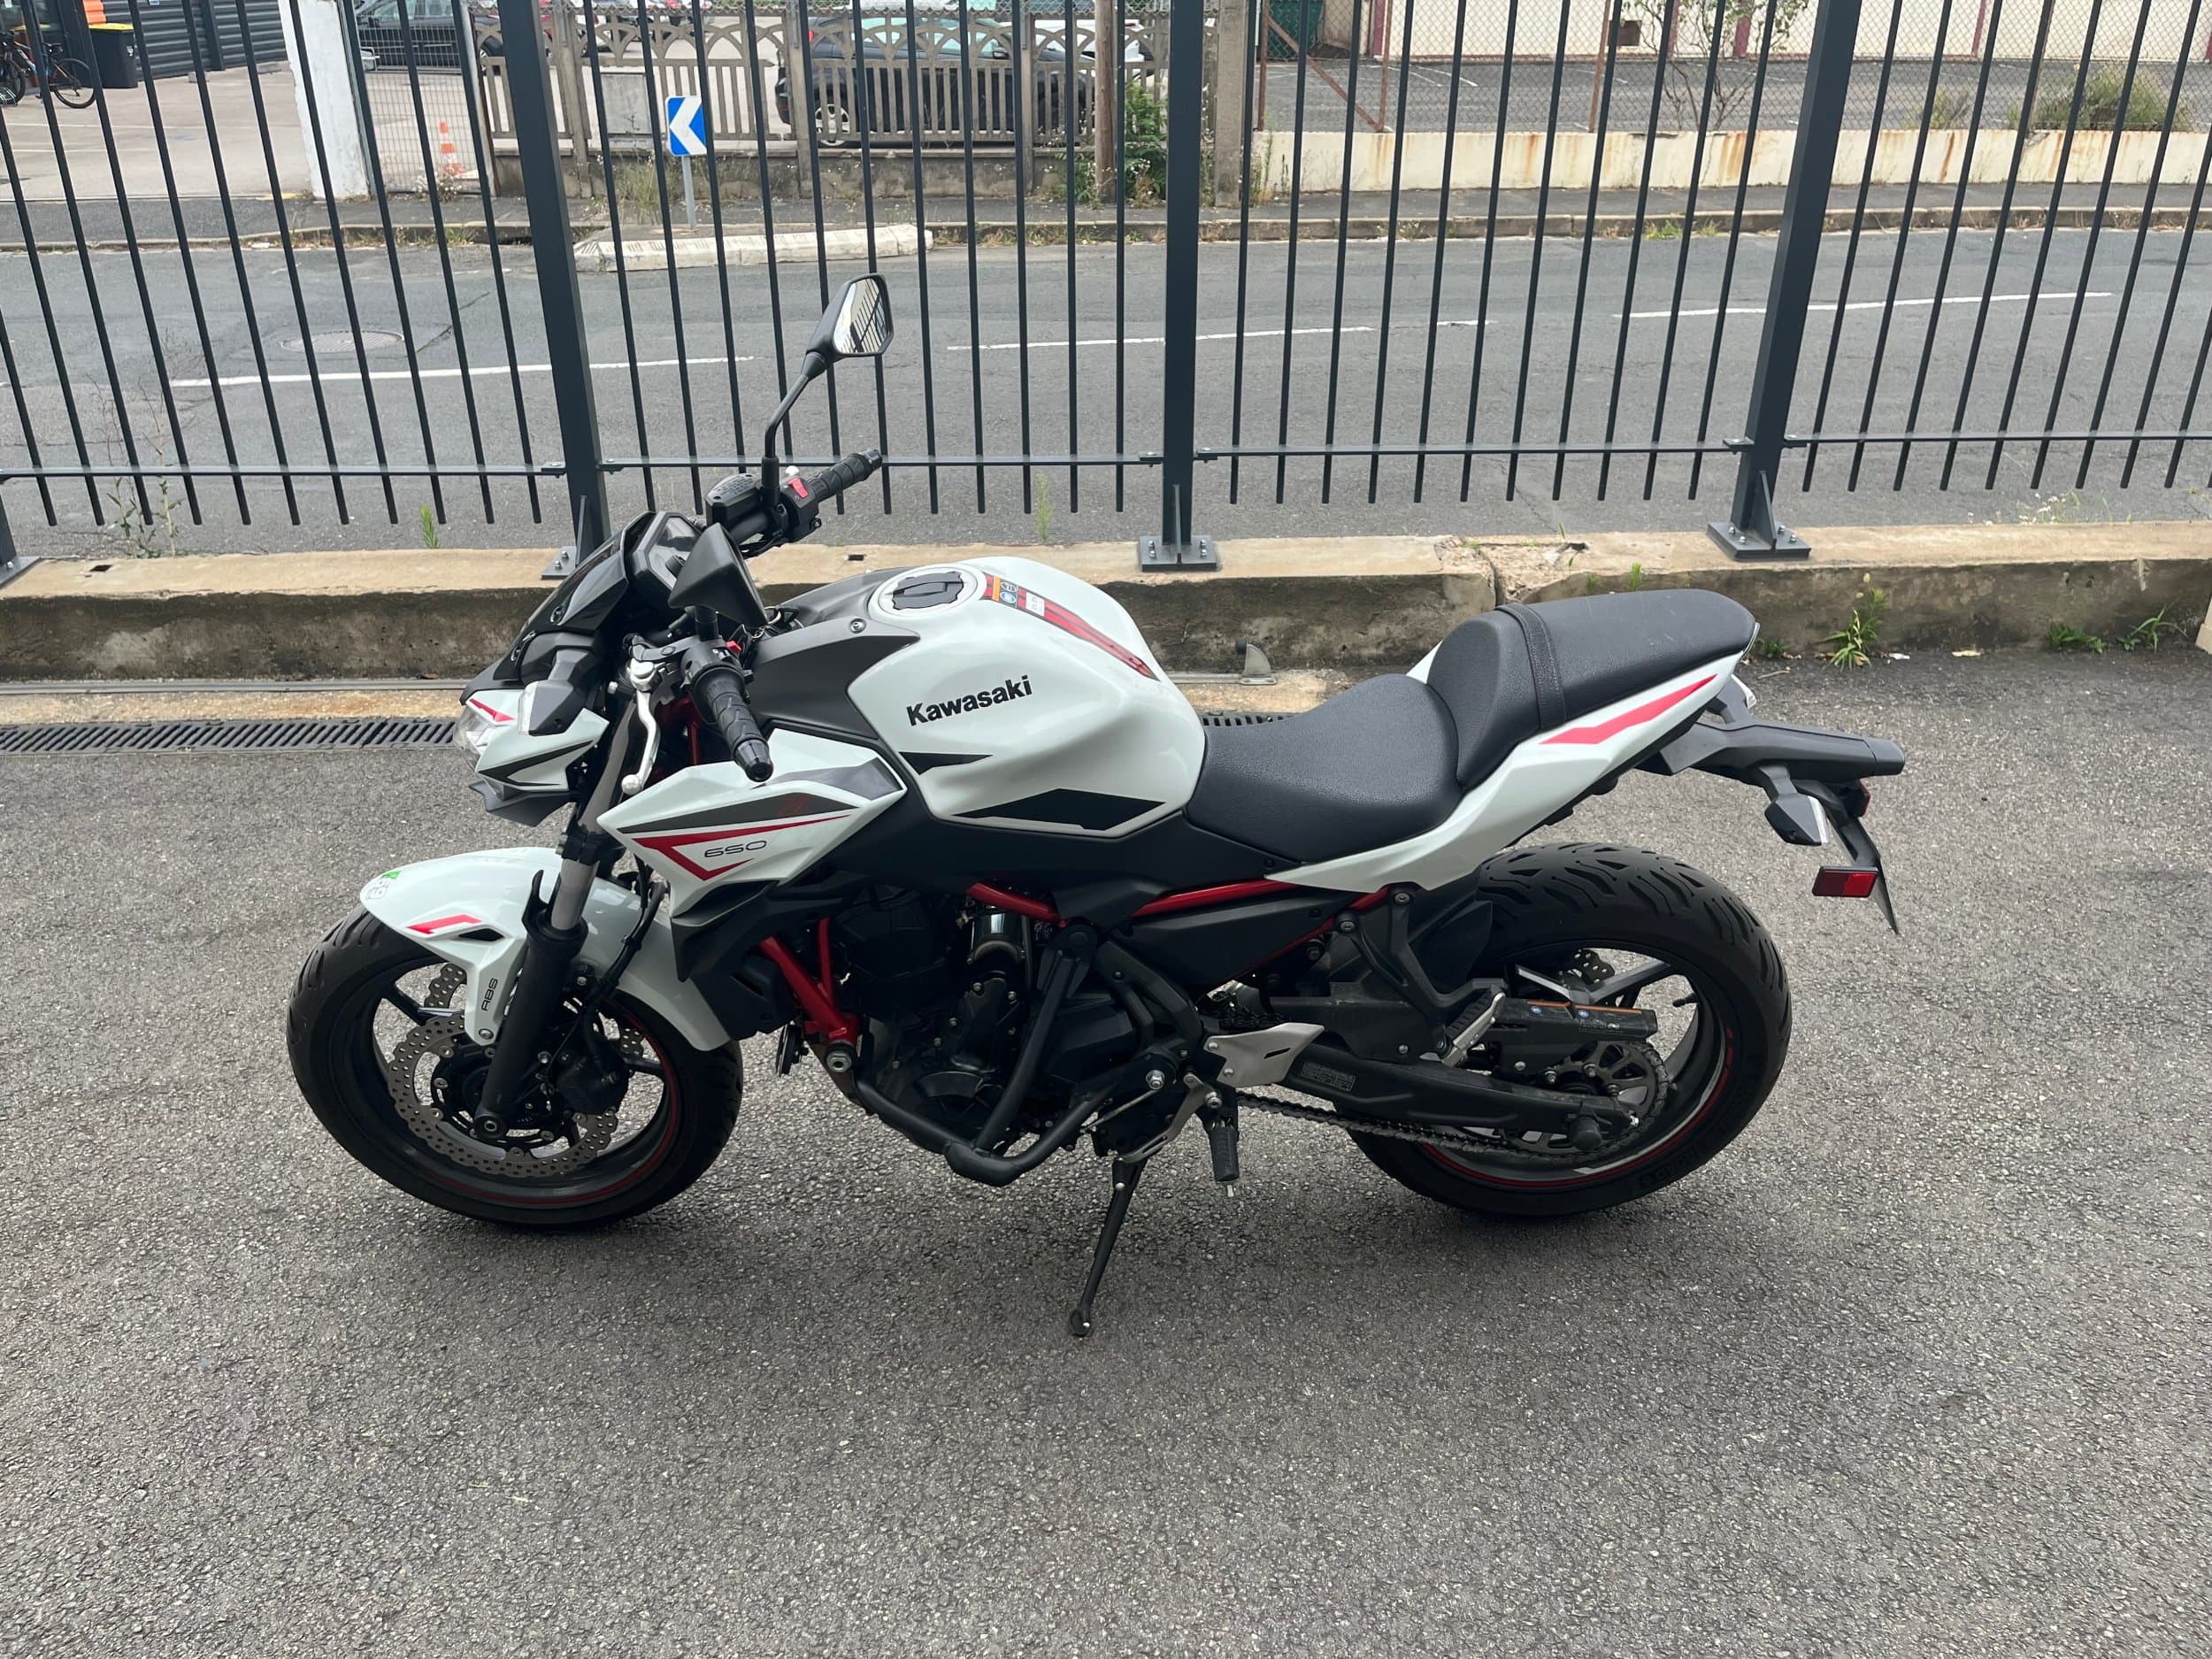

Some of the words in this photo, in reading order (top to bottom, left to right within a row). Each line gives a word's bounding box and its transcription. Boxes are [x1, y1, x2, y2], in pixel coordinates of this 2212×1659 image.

[906, 675, 1032, 726] Kawasaki
[704, 841, 767, 857] 650
[481, 978, 498, 1011] ABS
